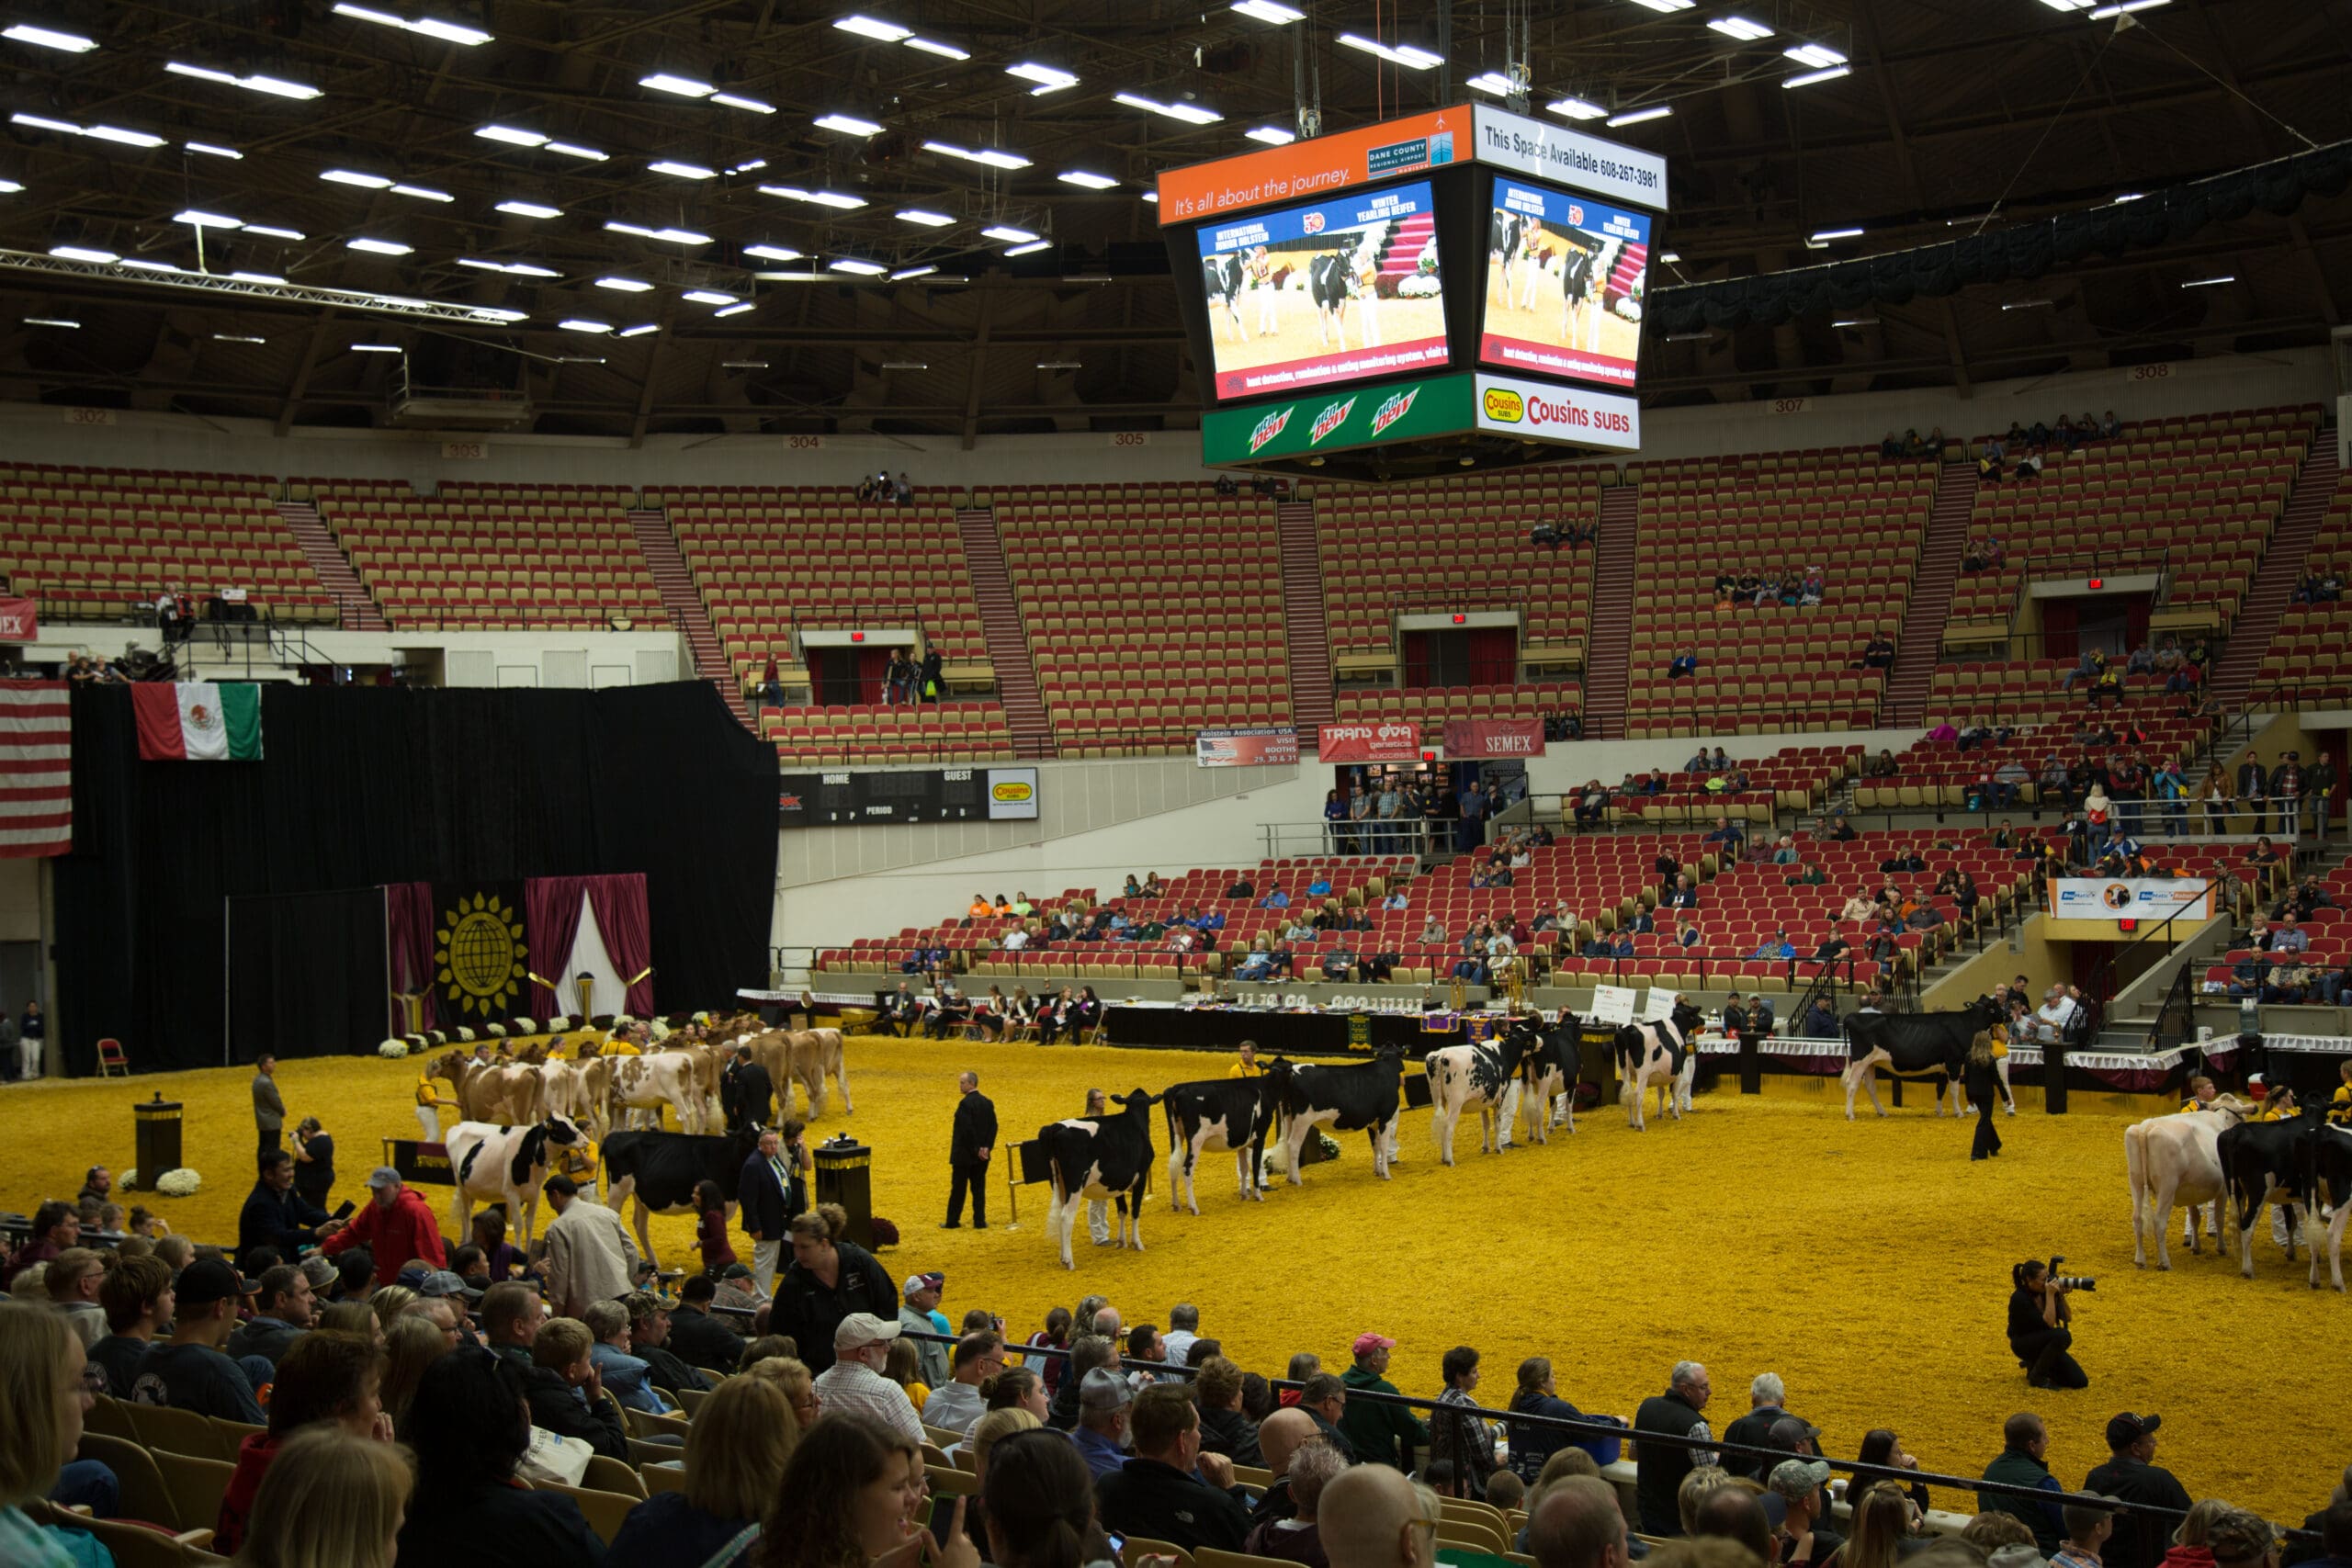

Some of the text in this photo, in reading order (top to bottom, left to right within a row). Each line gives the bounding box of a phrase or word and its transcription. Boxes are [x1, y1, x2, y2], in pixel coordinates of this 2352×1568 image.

[1370, 143, 1425, 161] DANE COUNTY
[1486, 125, 1657, 188] This Space Available 608-267-3981
[1370, 153, 1425, 168] REGIONAL AIRPORT
[1176, 167, 1351, 215] It's all about the journey.
[1372, 195, 1398, 209] WINTER
[1357, 201, 1417, 222] YEARLING HEIFER
[2135, 365, 2168, 379] 308
[1487, 395, 1521, 412] Cousins
[1775, 399, 1804, 412] 307
[74, 409, 107, 423] 302
[1498, 410, 1511, 418] SUBS
[1527, 396, 1630, 433] Cousins SUBS
[790, 436, 819, 448] 304
[1115, 434, 1145, 446] 305
[450, 445, 480, 457] 303
[1323, 728, 1373, 740] TRANS
[1370, 741, 1412, 750] genetics
[1486, 735, 1532, 752] SEMEX
[823, 773, 849, 784] HOME
[944, 770, 972, 781] GUEST
[996, 787, 1029, 796] Cousins
[849, 811, 855, 819] P
[866, 806, 892, 816] PERIOD
